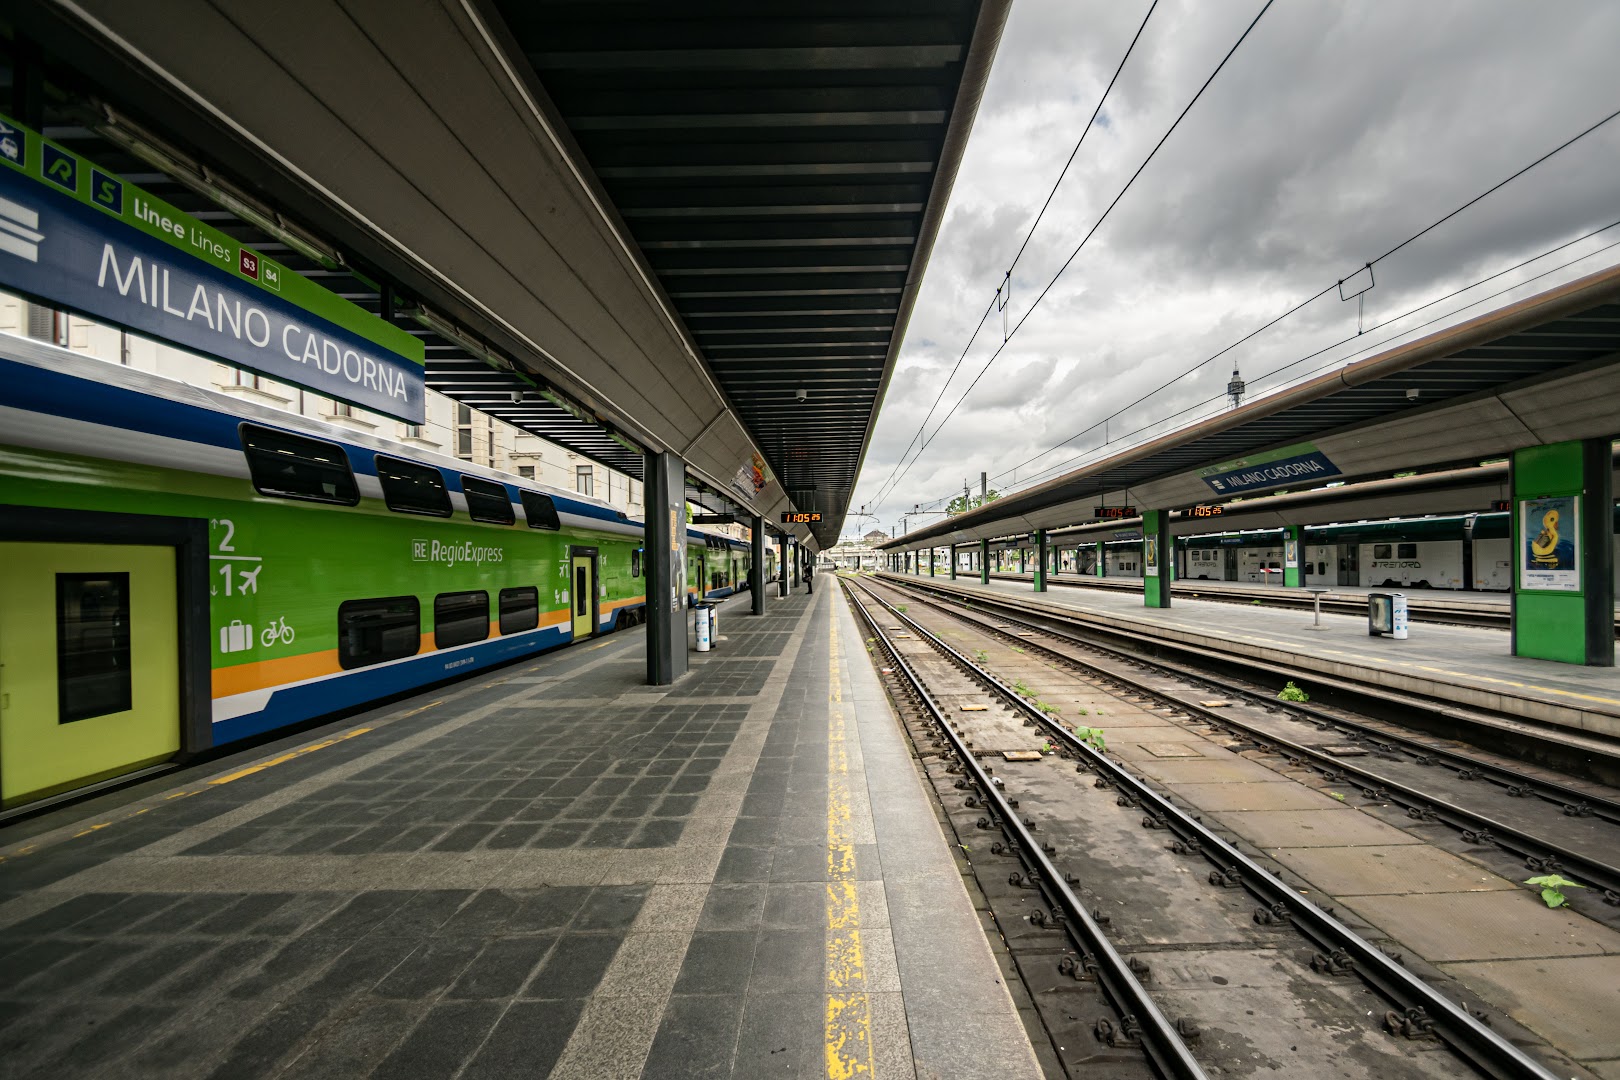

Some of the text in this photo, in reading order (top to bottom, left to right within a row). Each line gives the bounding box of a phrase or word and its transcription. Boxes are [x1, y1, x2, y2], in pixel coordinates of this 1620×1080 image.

[98, 181, 116, 204] S
[134, 198, 185, 239] Linee
[191, 228, 231, 263] Lines
[243, 257, 256, 272] S3
[265, 269, 277, 283] S4
[97, 243, 408, 403] MILANO CADORNA
[1226, 460, 1325, 487] MILANO CADORNA
[786, 513, 821, 523] 11:05 25
[1100, 507, 1123, 518] 11:05
[1188, 507, 1222, 517] 11:05 25
[219, 519, 235, 552] 2
[414, 540, 503, 567] RE RegioExpress
[1378, 561, 1421, 569] TRENORD
[219, 563, 232, 596] 1
